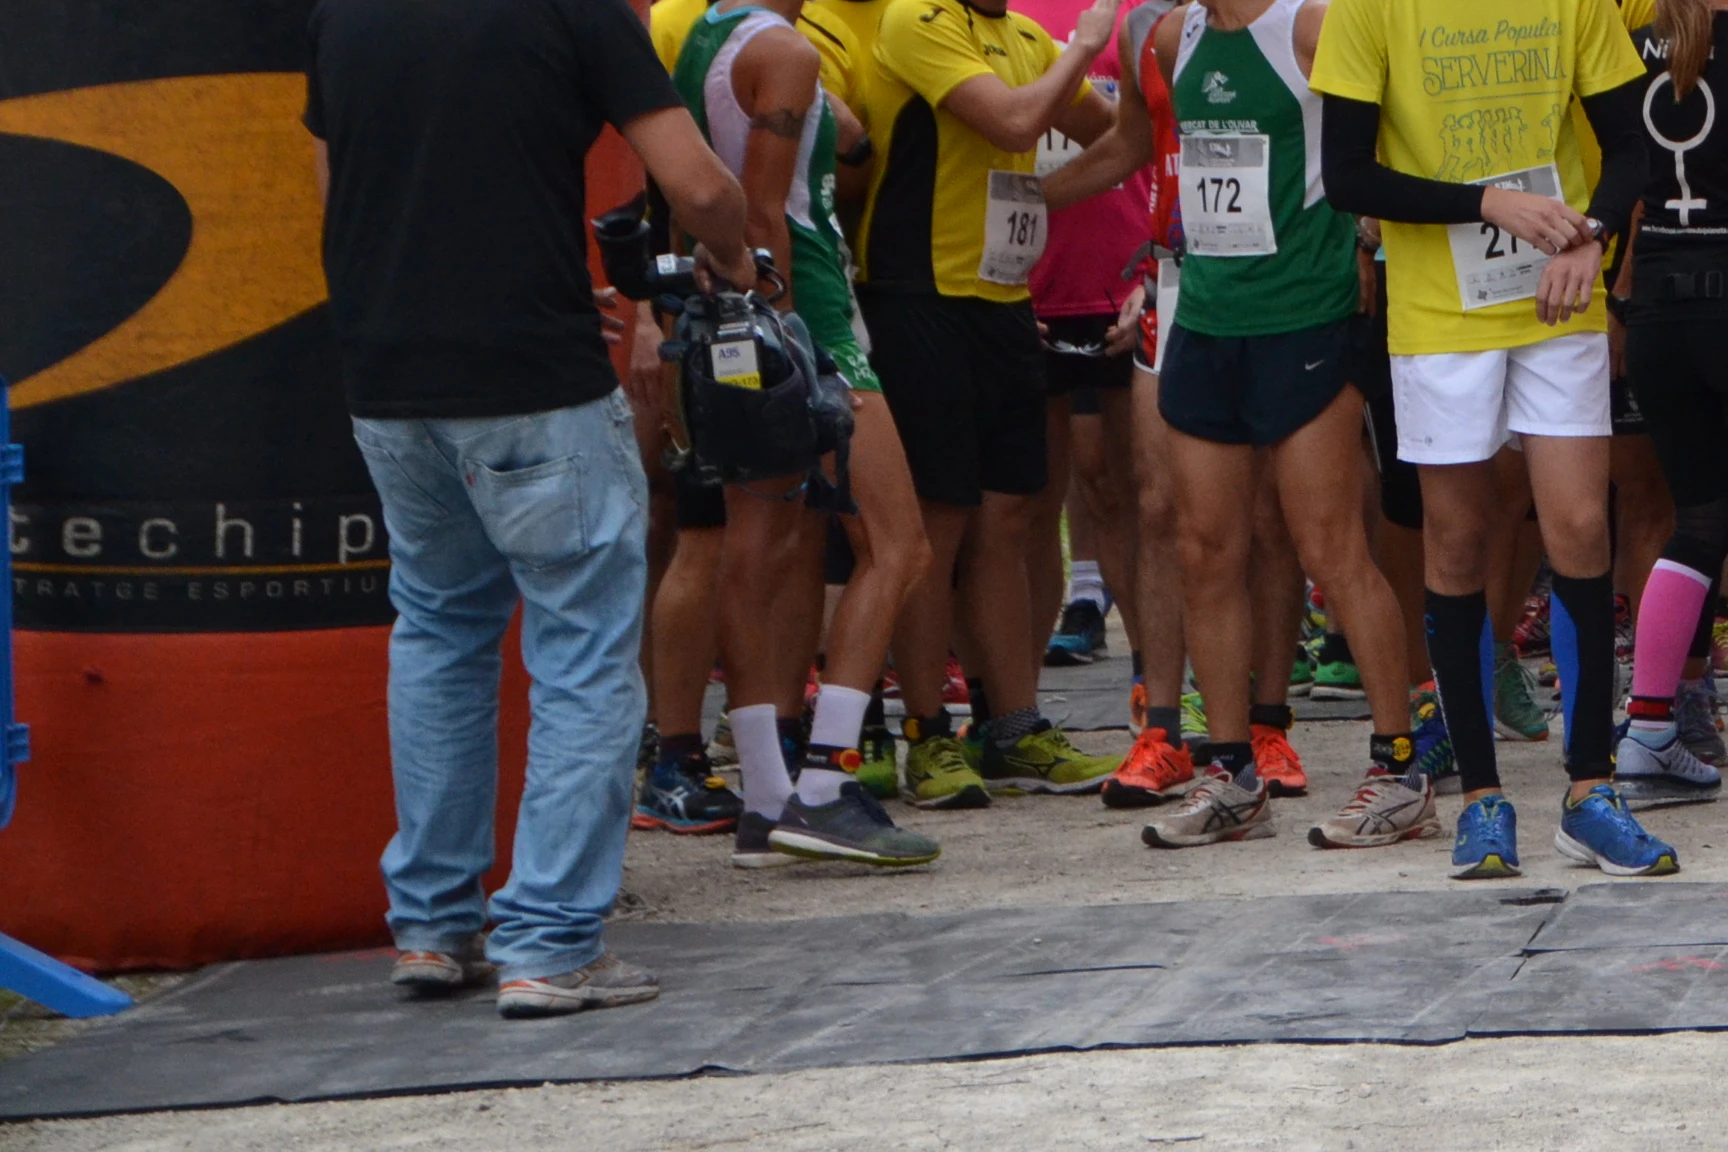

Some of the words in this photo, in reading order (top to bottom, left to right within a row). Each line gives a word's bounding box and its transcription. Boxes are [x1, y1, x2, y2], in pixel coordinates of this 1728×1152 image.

[1431, 25, 1489, 47] Cursa
[1421, 46, 1568, 97] SERVERINA
[1196, 176, 1242, 214] 172
[1006, 210, 1038, 247] 181
